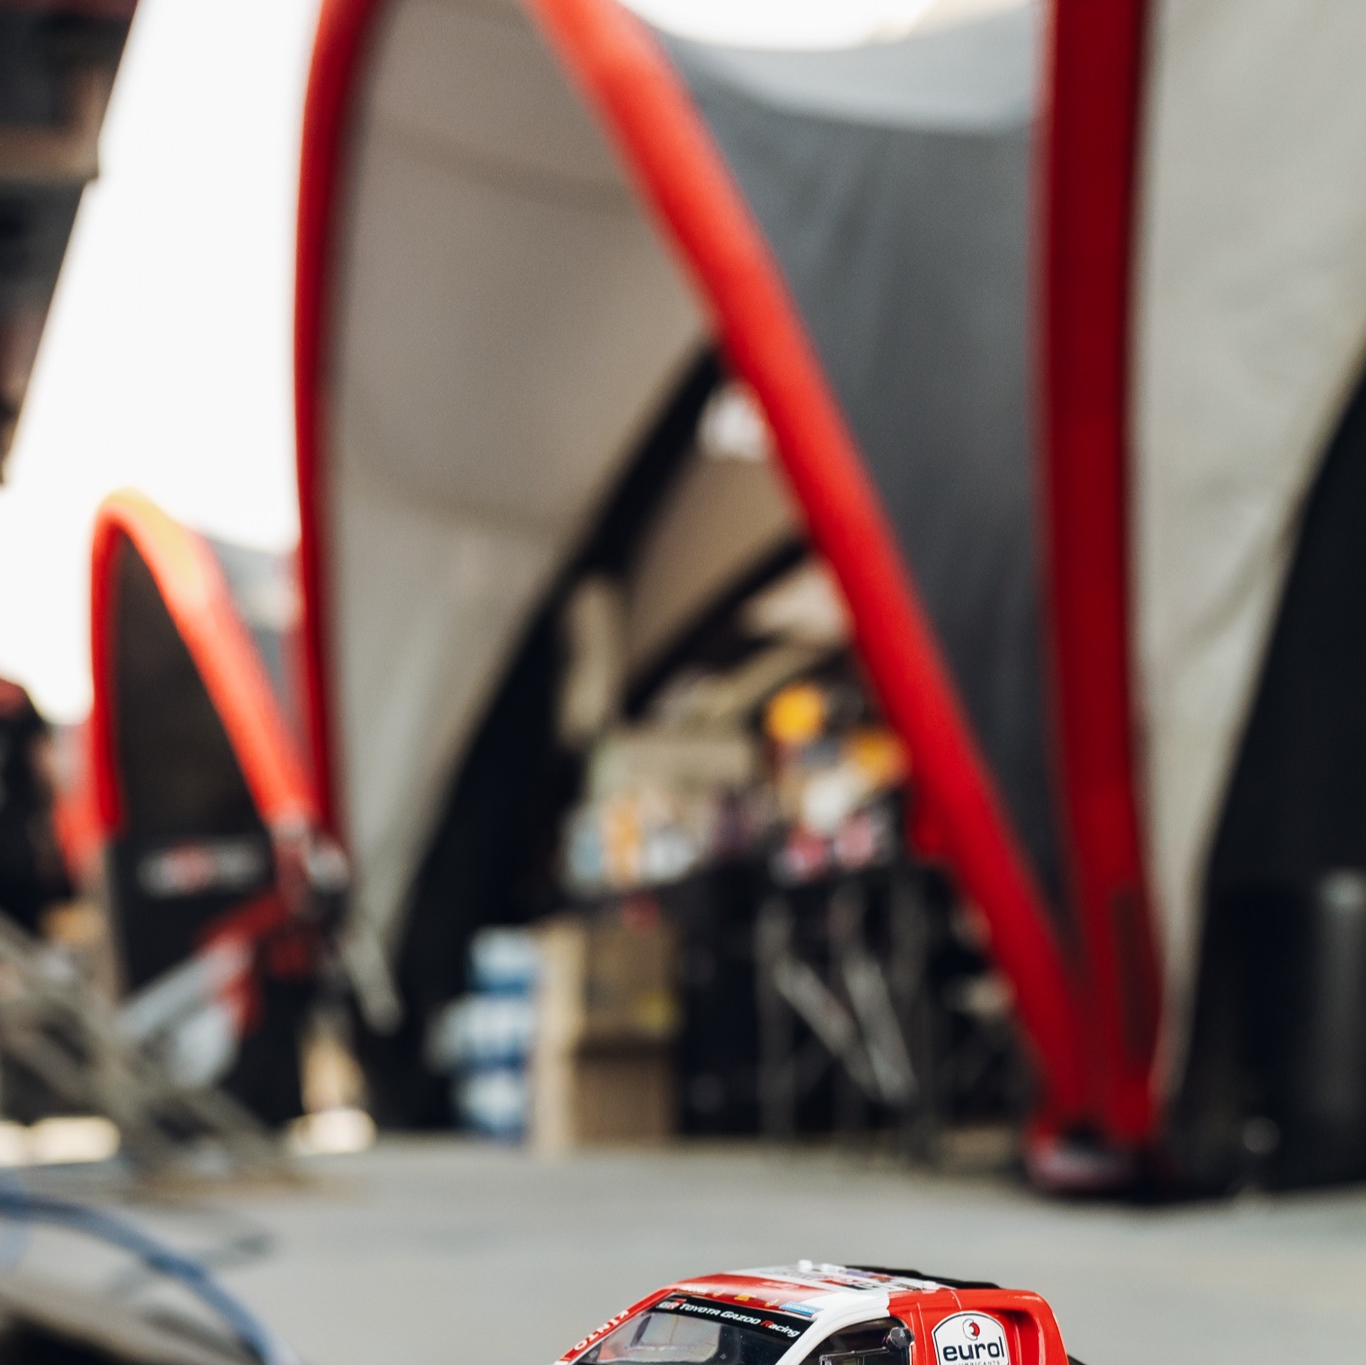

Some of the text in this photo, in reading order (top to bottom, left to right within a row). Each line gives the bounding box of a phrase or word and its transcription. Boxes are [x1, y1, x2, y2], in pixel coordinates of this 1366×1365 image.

[679, 1302, 720, 1316] TOYOTA
[720, 1310, 762, 1325] GAZOO
[760, 1319, 801, 1338] Racing
[942, 1335, 1005, 1362] eurol
